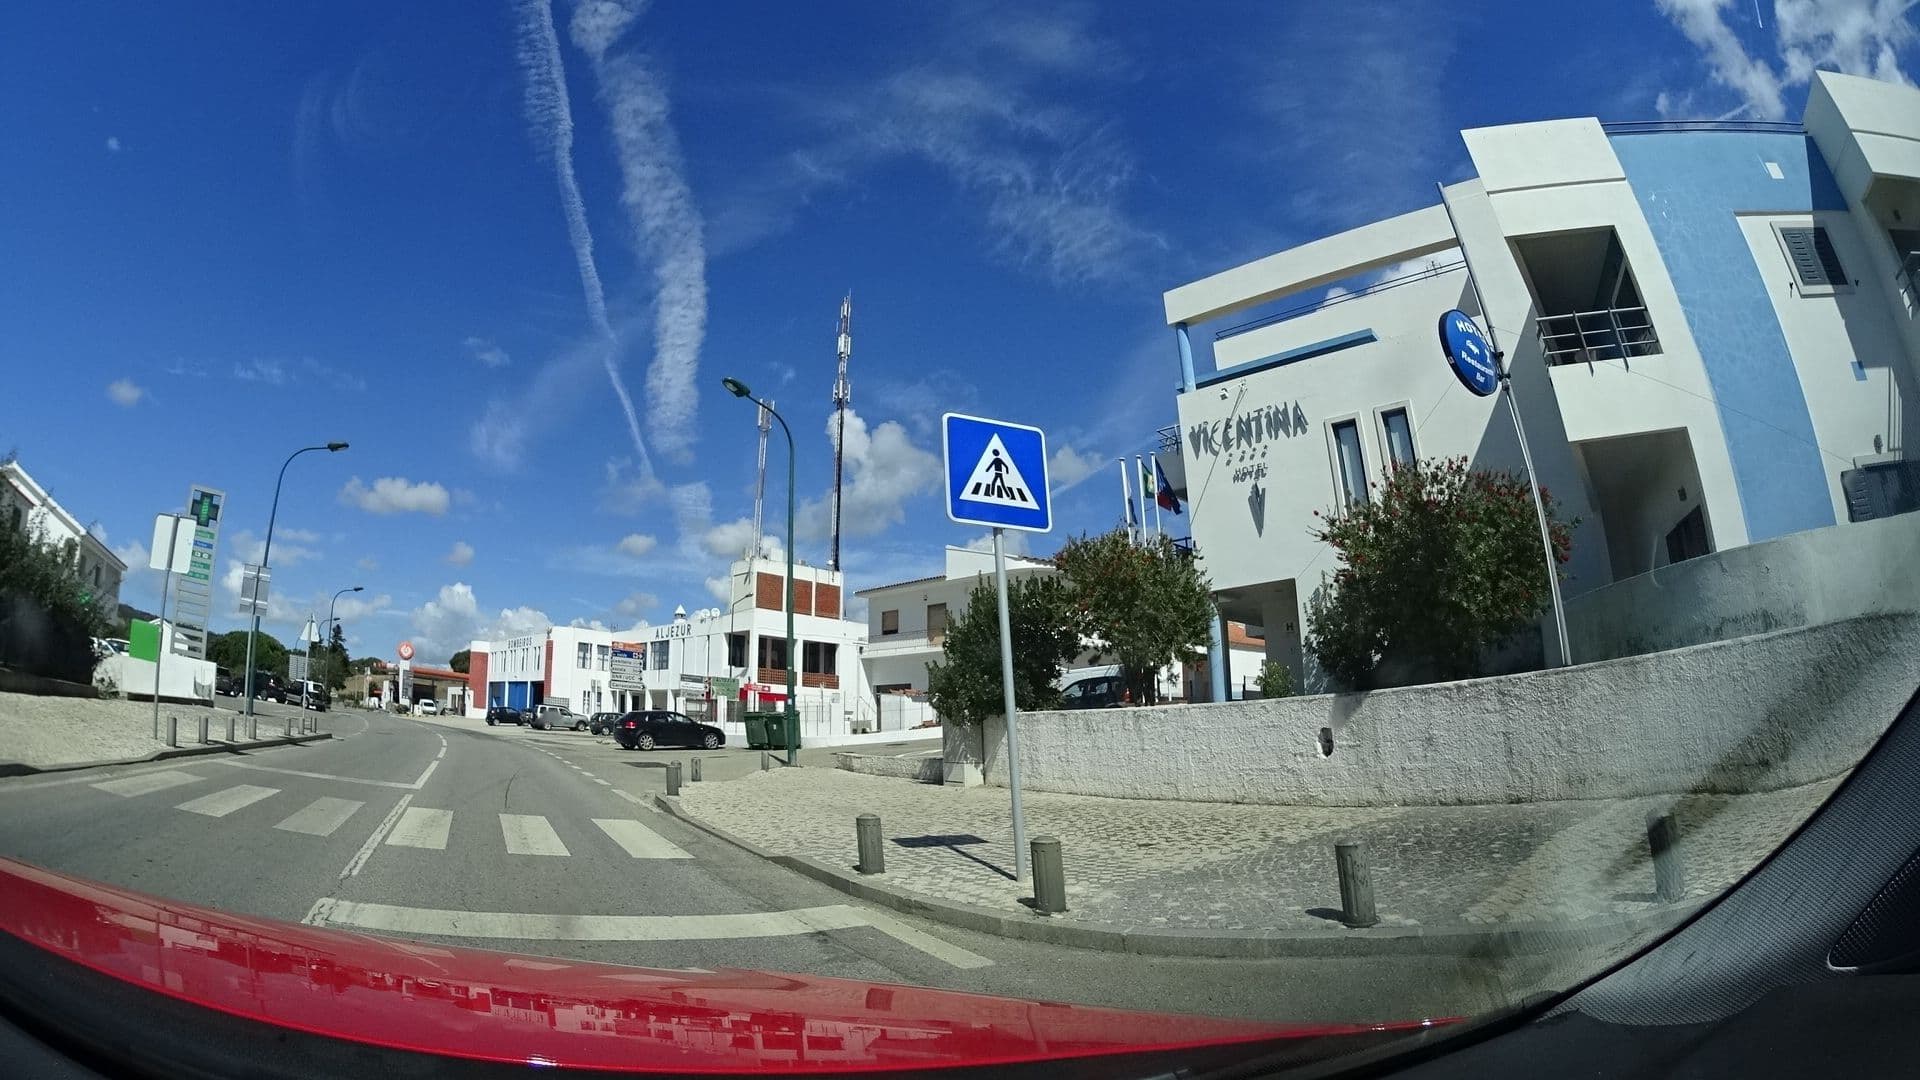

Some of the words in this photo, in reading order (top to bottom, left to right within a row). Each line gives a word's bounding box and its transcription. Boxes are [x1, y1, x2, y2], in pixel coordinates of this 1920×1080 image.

[1234, 462, 1268, 479] HOTEL
[654, 623, 692, 640] ALJEZUR
[507, 636, 532, 649] BOMBEIROS
